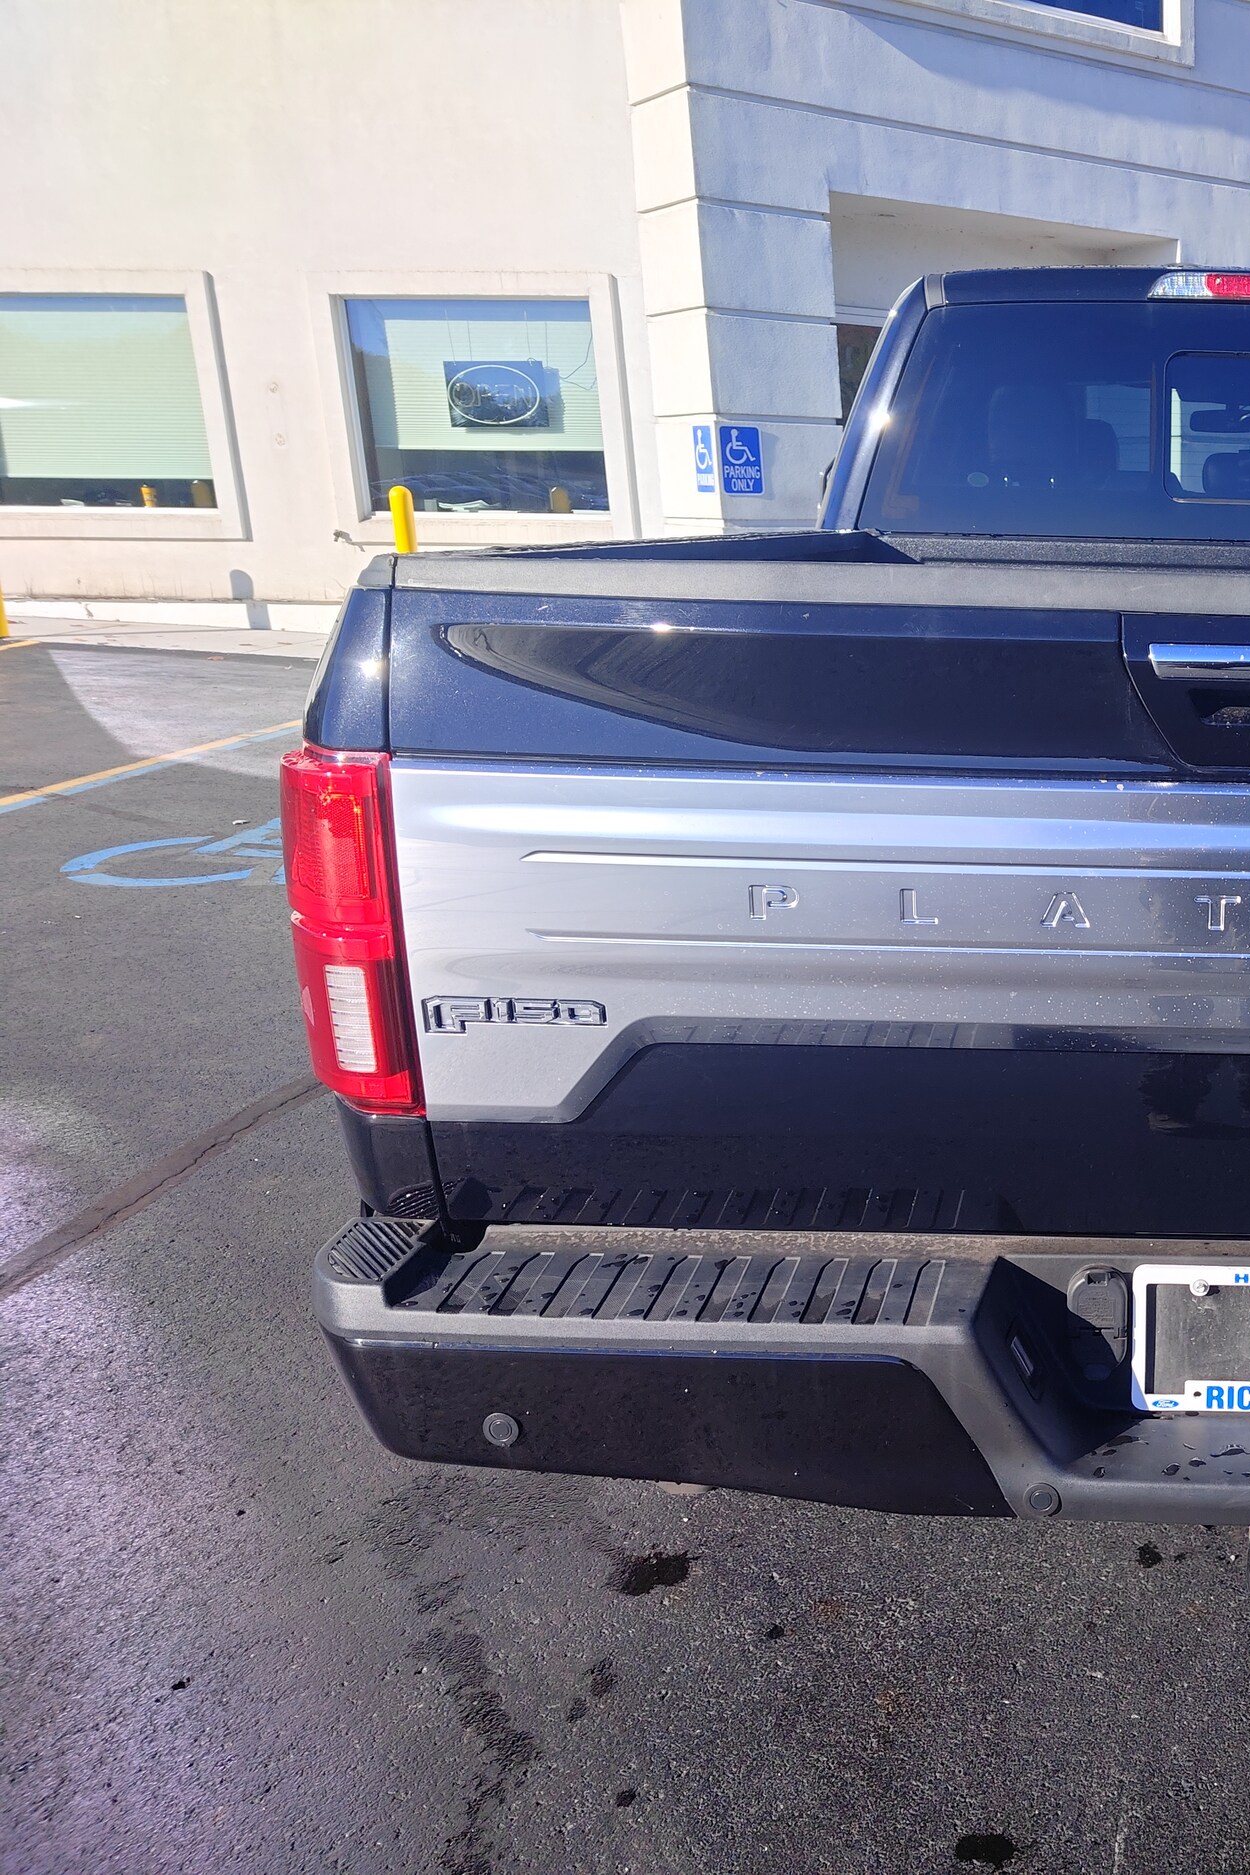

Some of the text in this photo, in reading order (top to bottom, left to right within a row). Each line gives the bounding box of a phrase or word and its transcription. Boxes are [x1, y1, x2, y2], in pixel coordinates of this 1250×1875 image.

[453, 382, 533, 408] OPEN
[724, 465, 760, 479] PARKING
[731, 479, 755, 491] ONLY
